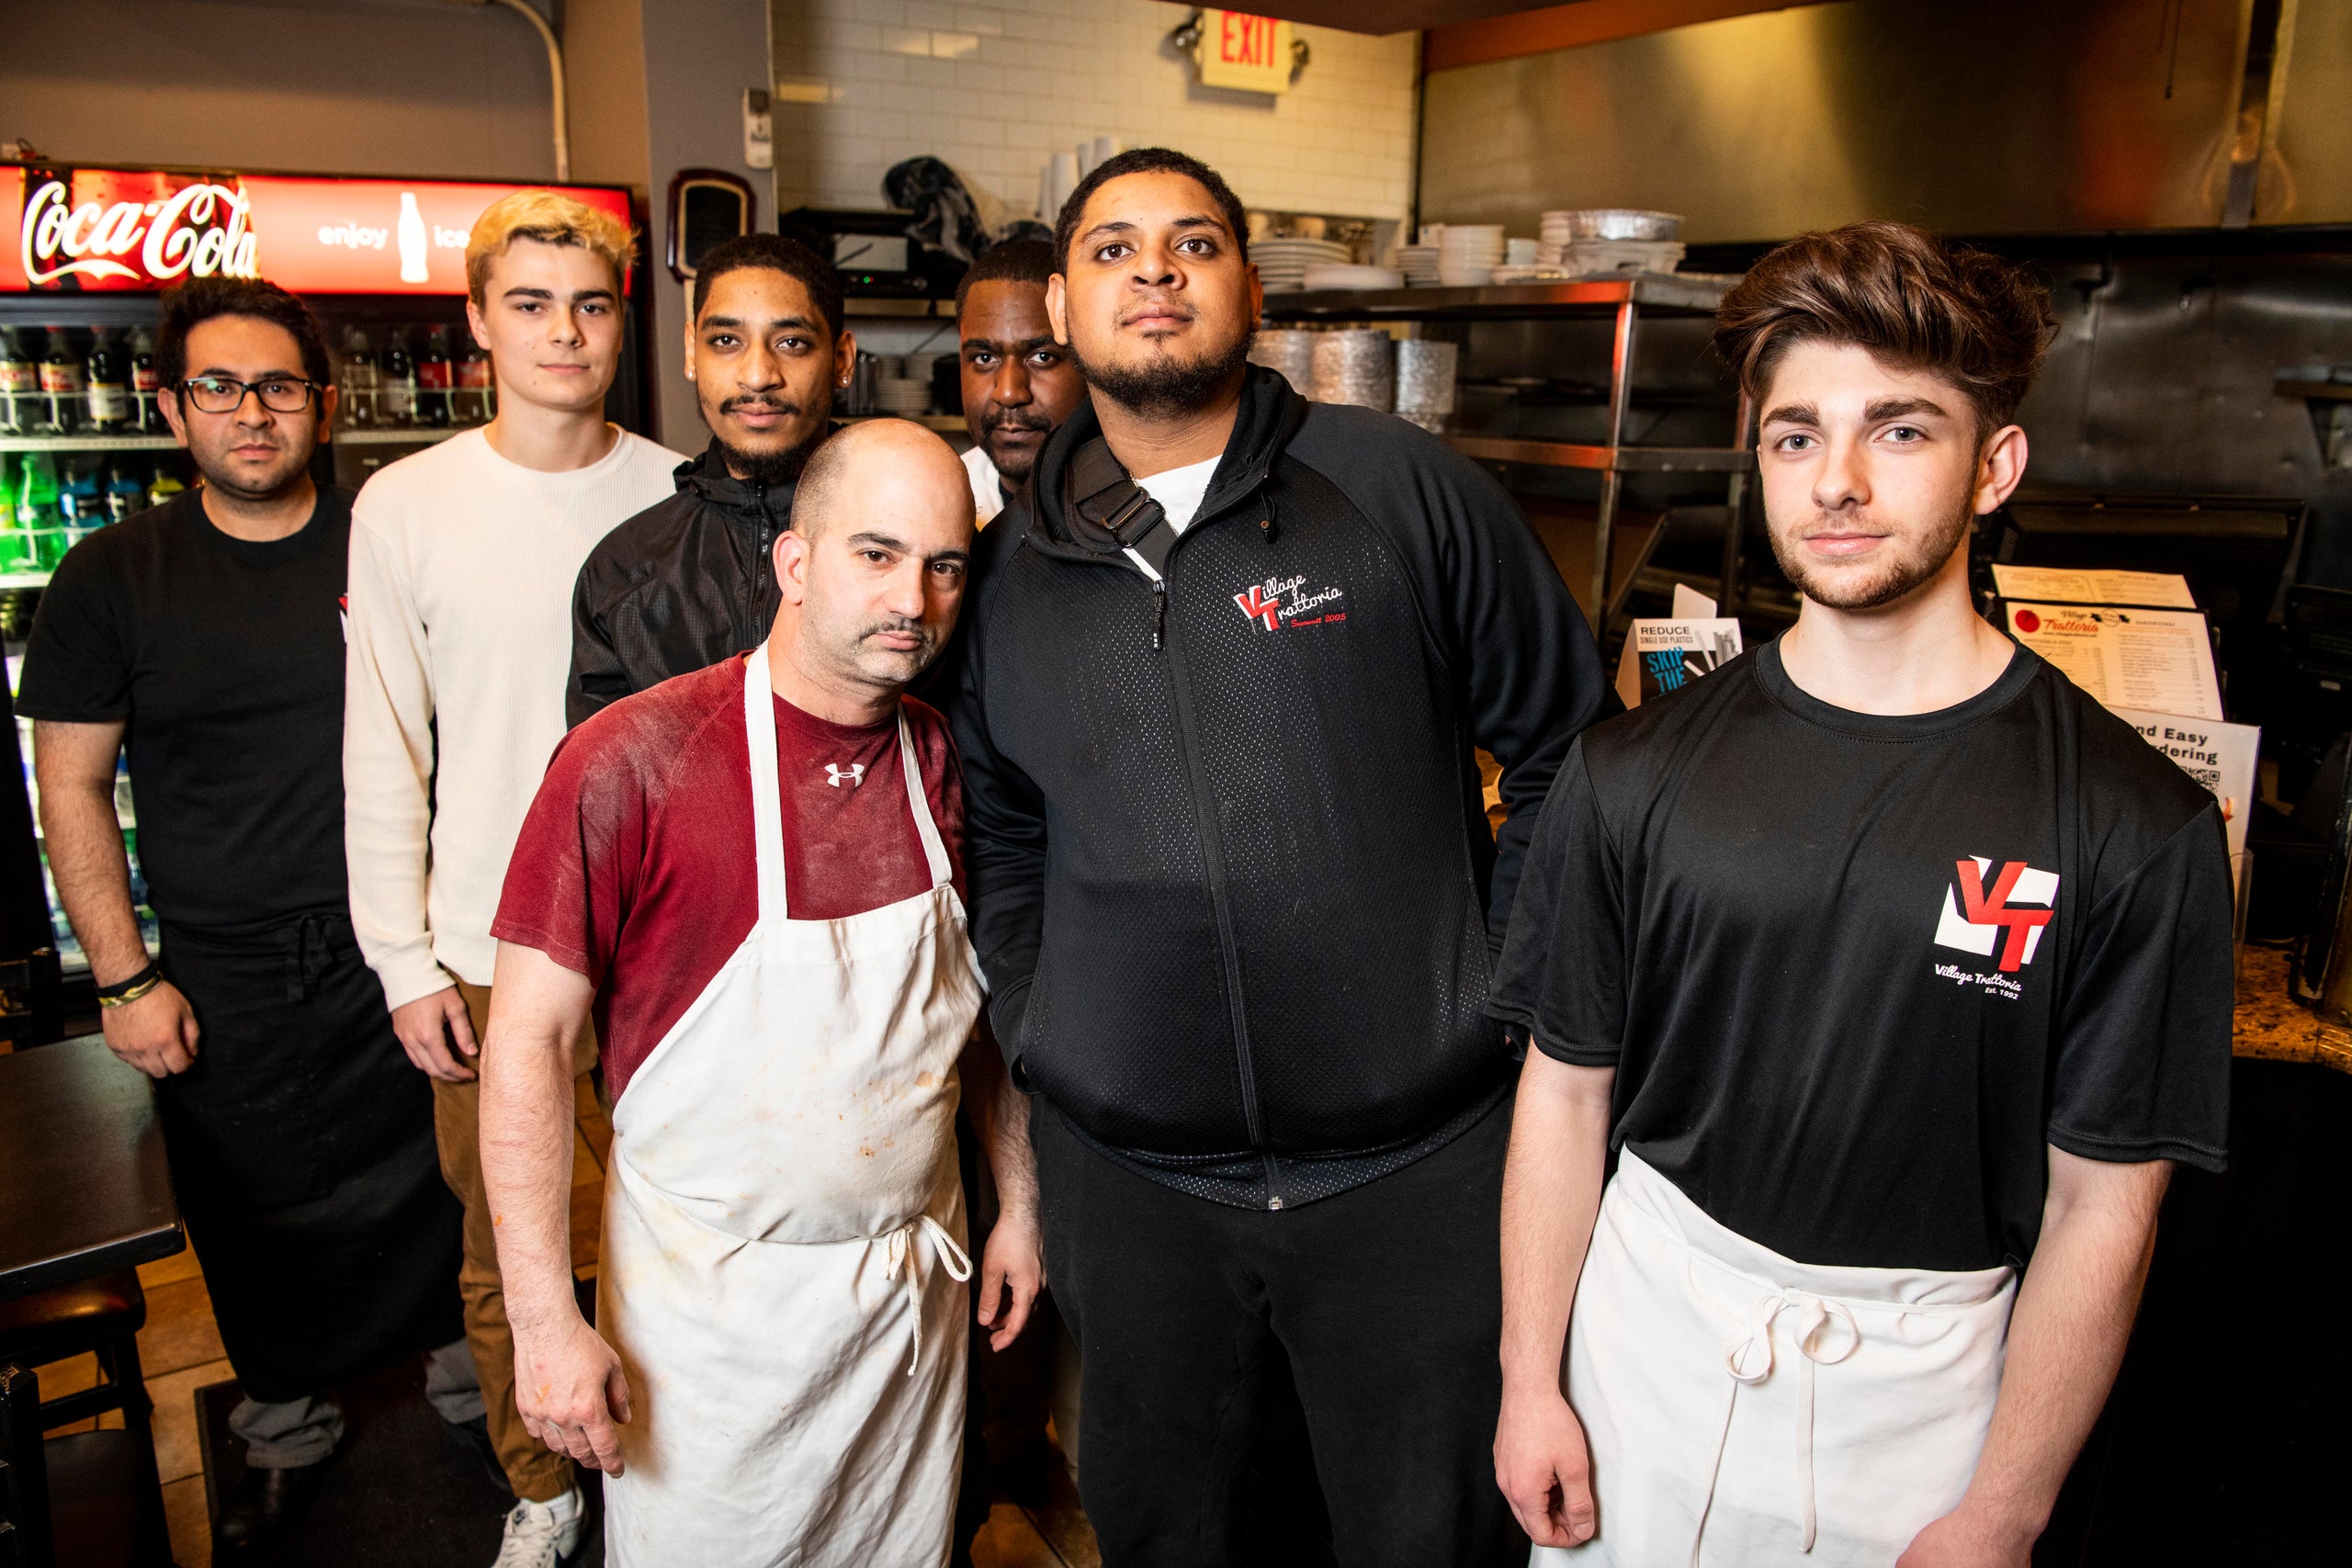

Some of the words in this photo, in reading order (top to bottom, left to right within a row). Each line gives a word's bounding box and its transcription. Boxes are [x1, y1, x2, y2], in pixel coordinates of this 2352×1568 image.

[1221, 9, 1281, 68] EXIT
[22, 181, 259, 285] Coca-Cola
[318, 222, 388, 250] enjoy
[1641, 626, 1690, 635] REDUCE
[2043, 619, 2099, 633] Trattoria
[1640, 636, 1657, 644] SINGLE
[1659, 636, 1669, 644] USE
[1670, 636, 1693, 644] PLASTICS
[1646, 646, 1684, 673] SKIP
[1655, 666, 1687, 693] THE
[2135, 726, 2156, 737] nd
[2165, 728, 2209, 747] Easy
[1956, 860, 2055, 973] VT
[1935, 964, 1973, 985] Village
[1975, 973, 2022, 992] Trattoria
[1999, 988, 2018, 1000] 1992
